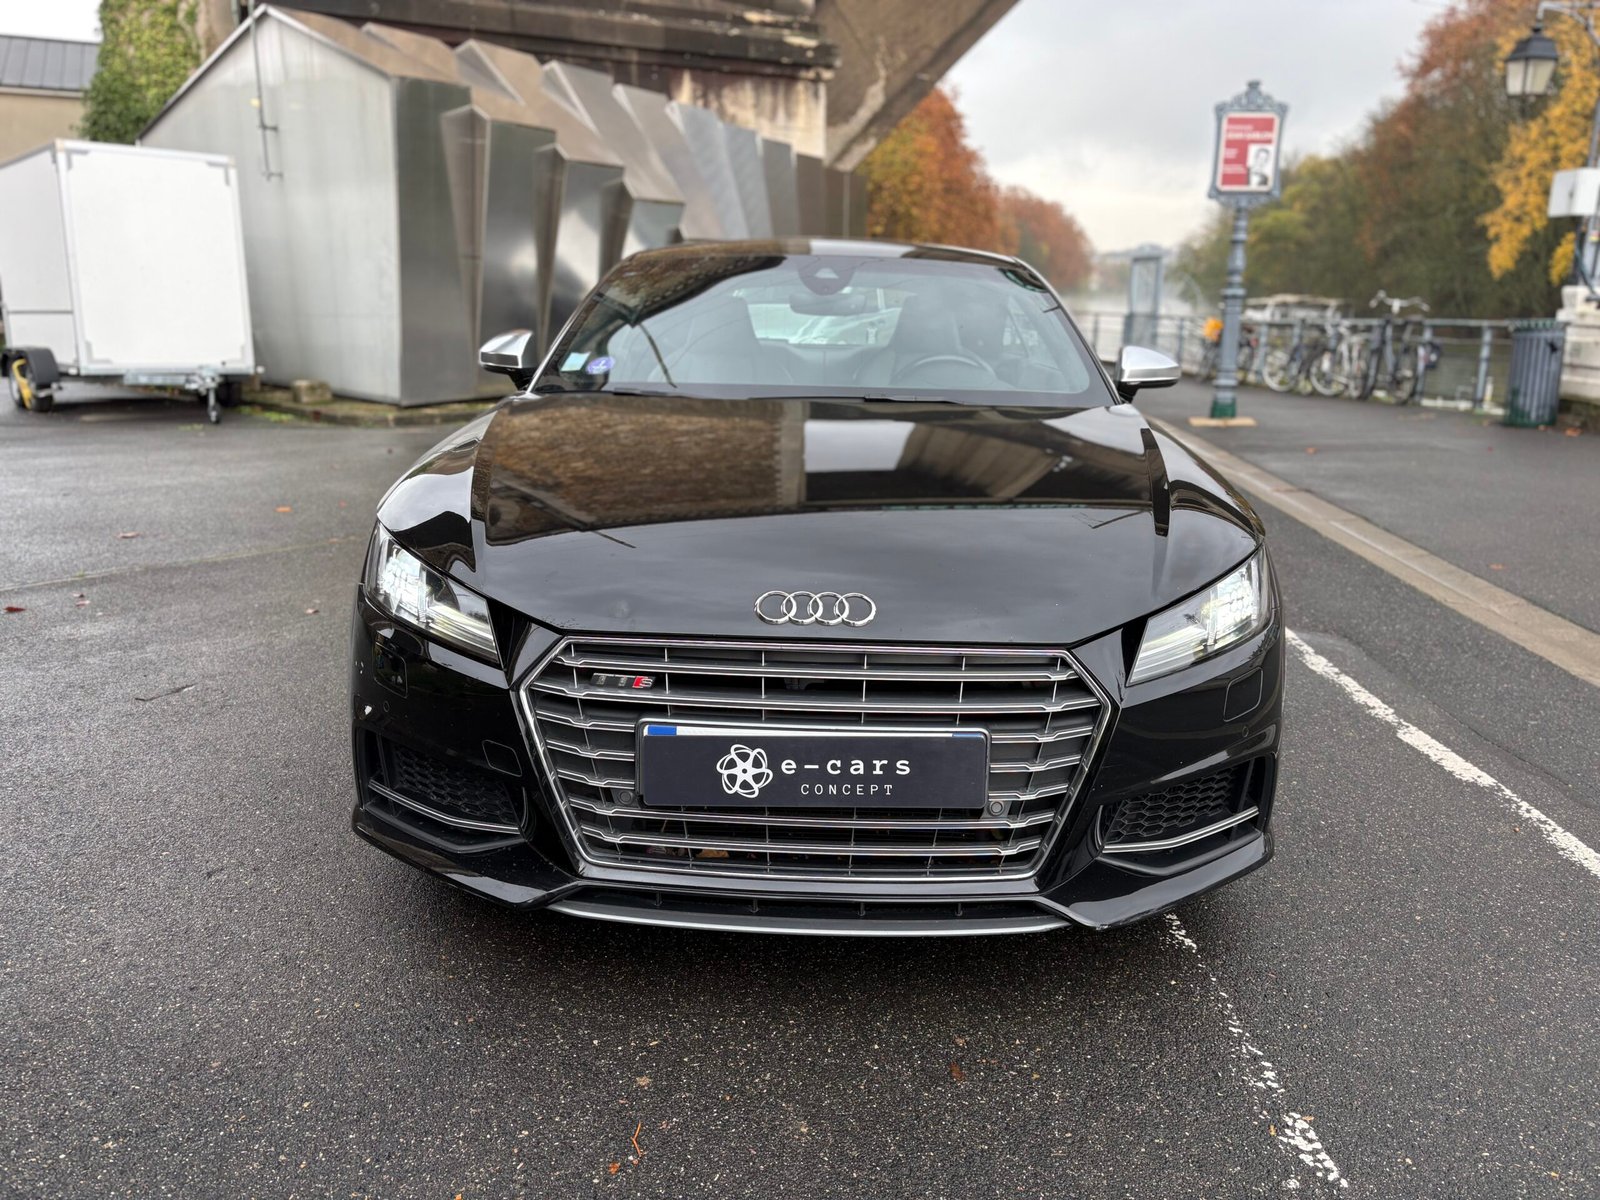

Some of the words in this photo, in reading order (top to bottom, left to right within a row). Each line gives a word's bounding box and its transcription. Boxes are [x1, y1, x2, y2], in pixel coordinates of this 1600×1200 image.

[592, 672, 654, 688] TTS
[780, 759, 911, 775] e-cars
[800, 784, 893, 796] CONCEPT
